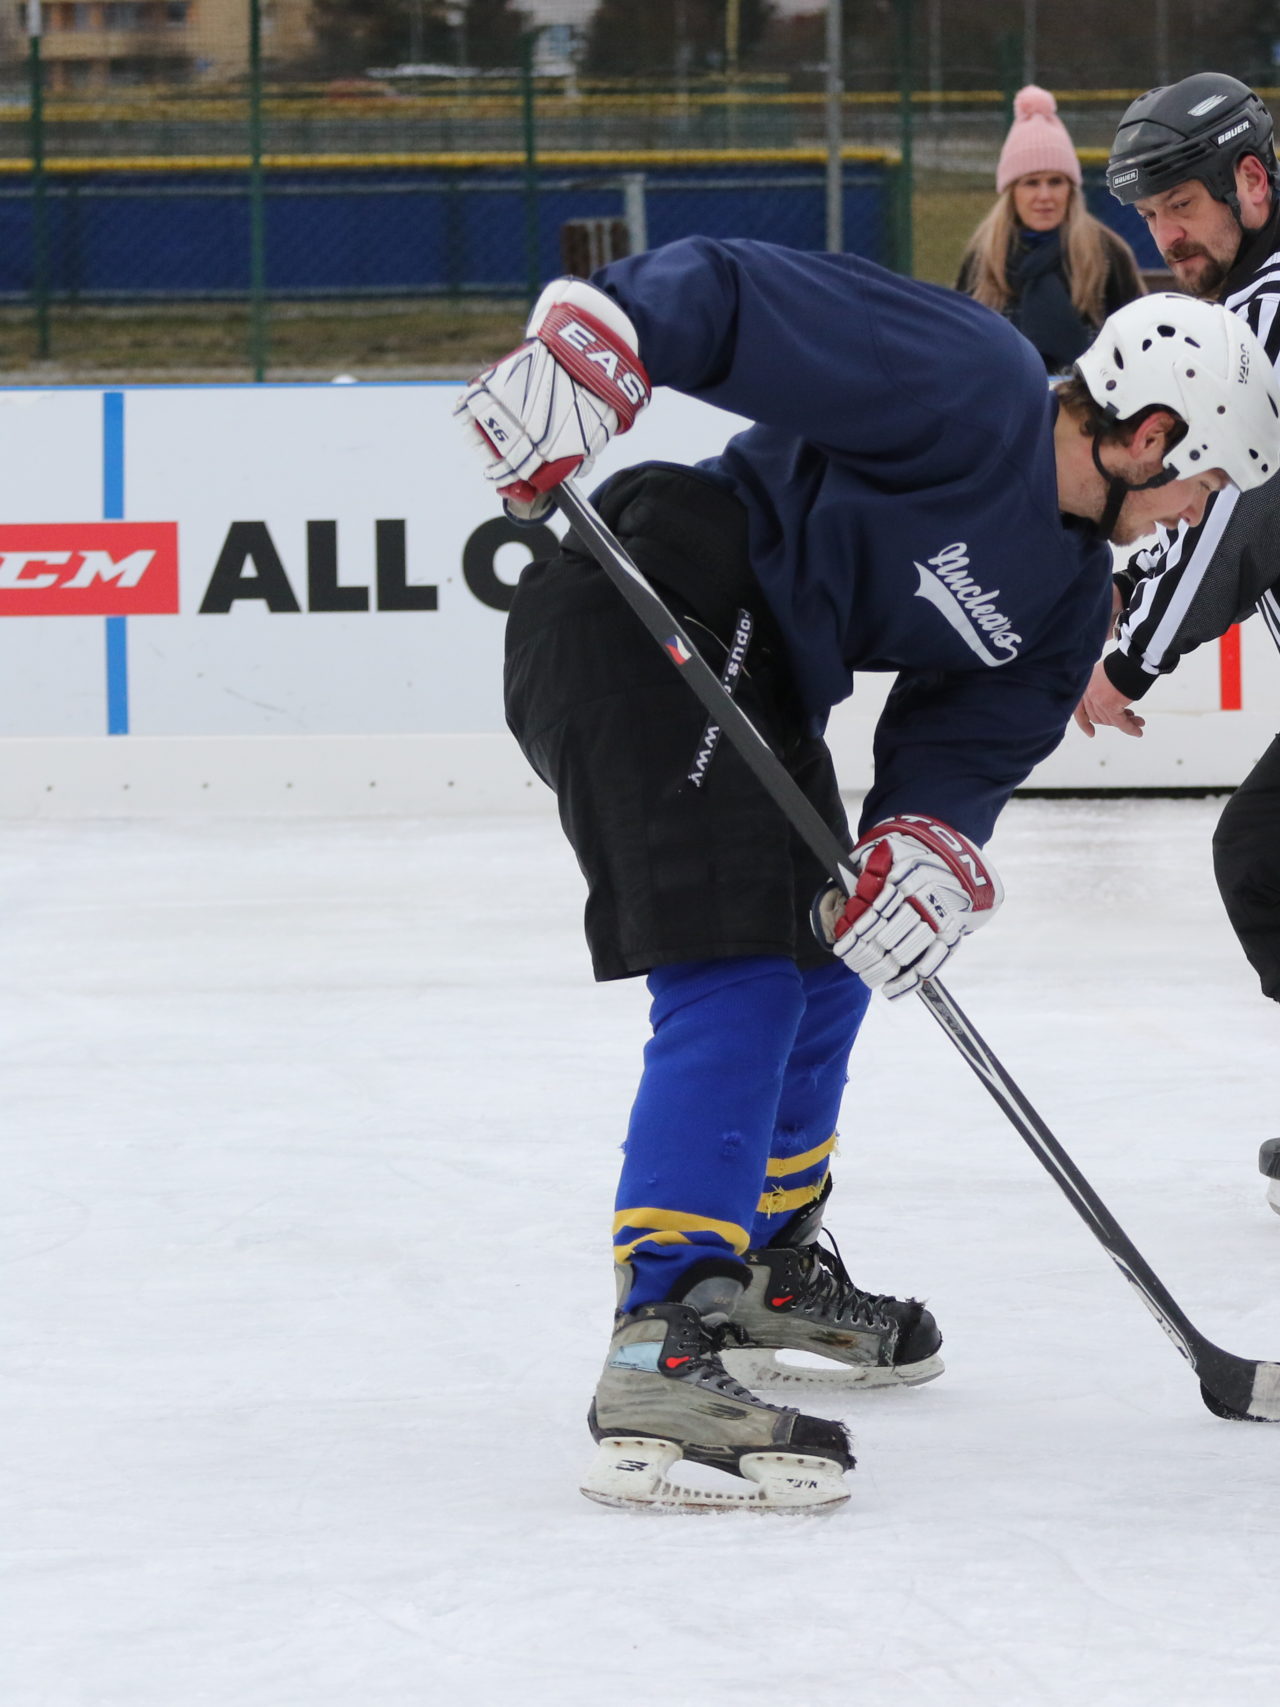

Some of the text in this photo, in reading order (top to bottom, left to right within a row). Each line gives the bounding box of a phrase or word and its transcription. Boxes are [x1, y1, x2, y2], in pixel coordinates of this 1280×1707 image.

[558, 321, 647, 405] EAS
[0, 550, 156, 589] CM
[198, 519, 438, 614] ALL
[926, 541, 1023, 664] Nuclears
